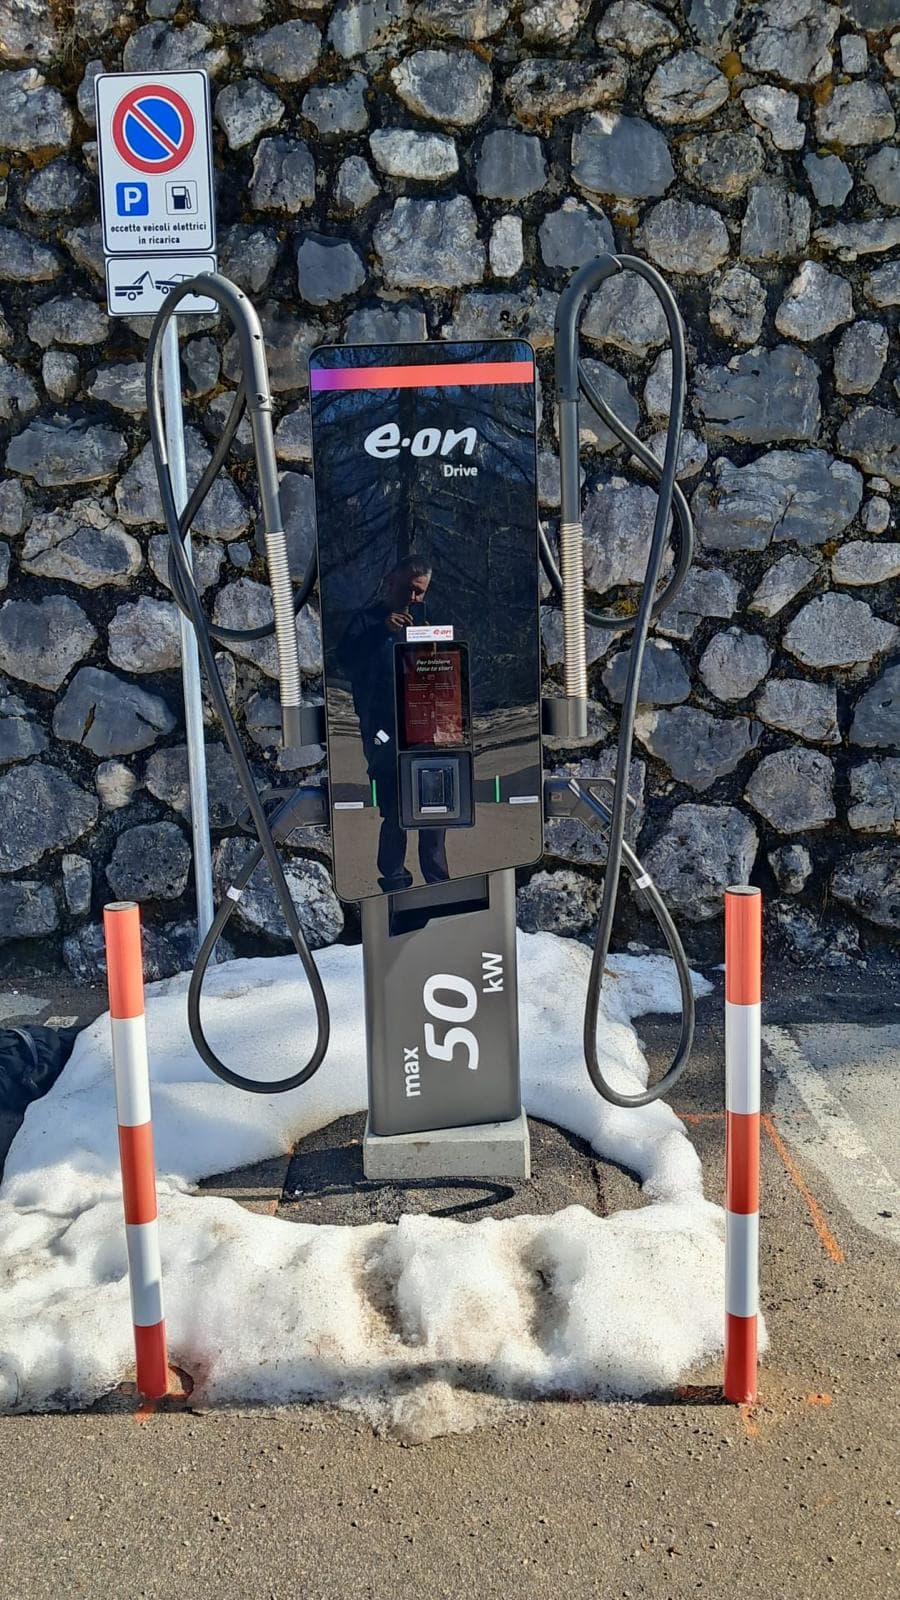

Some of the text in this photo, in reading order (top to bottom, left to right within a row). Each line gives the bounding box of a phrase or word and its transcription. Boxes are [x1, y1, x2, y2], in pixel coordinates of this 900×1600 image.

[123, 186, 142, 212] P
[110, 221, 207, 233] eccetto veicoli elettrici
[138, 235, 181, 245] in ricarica
[443, 464, 478, 478] Drive
[482, 951, 504, 993] kW
[423, 973, 480, 1071] 50
[403, 1046, 421, 1098] max
